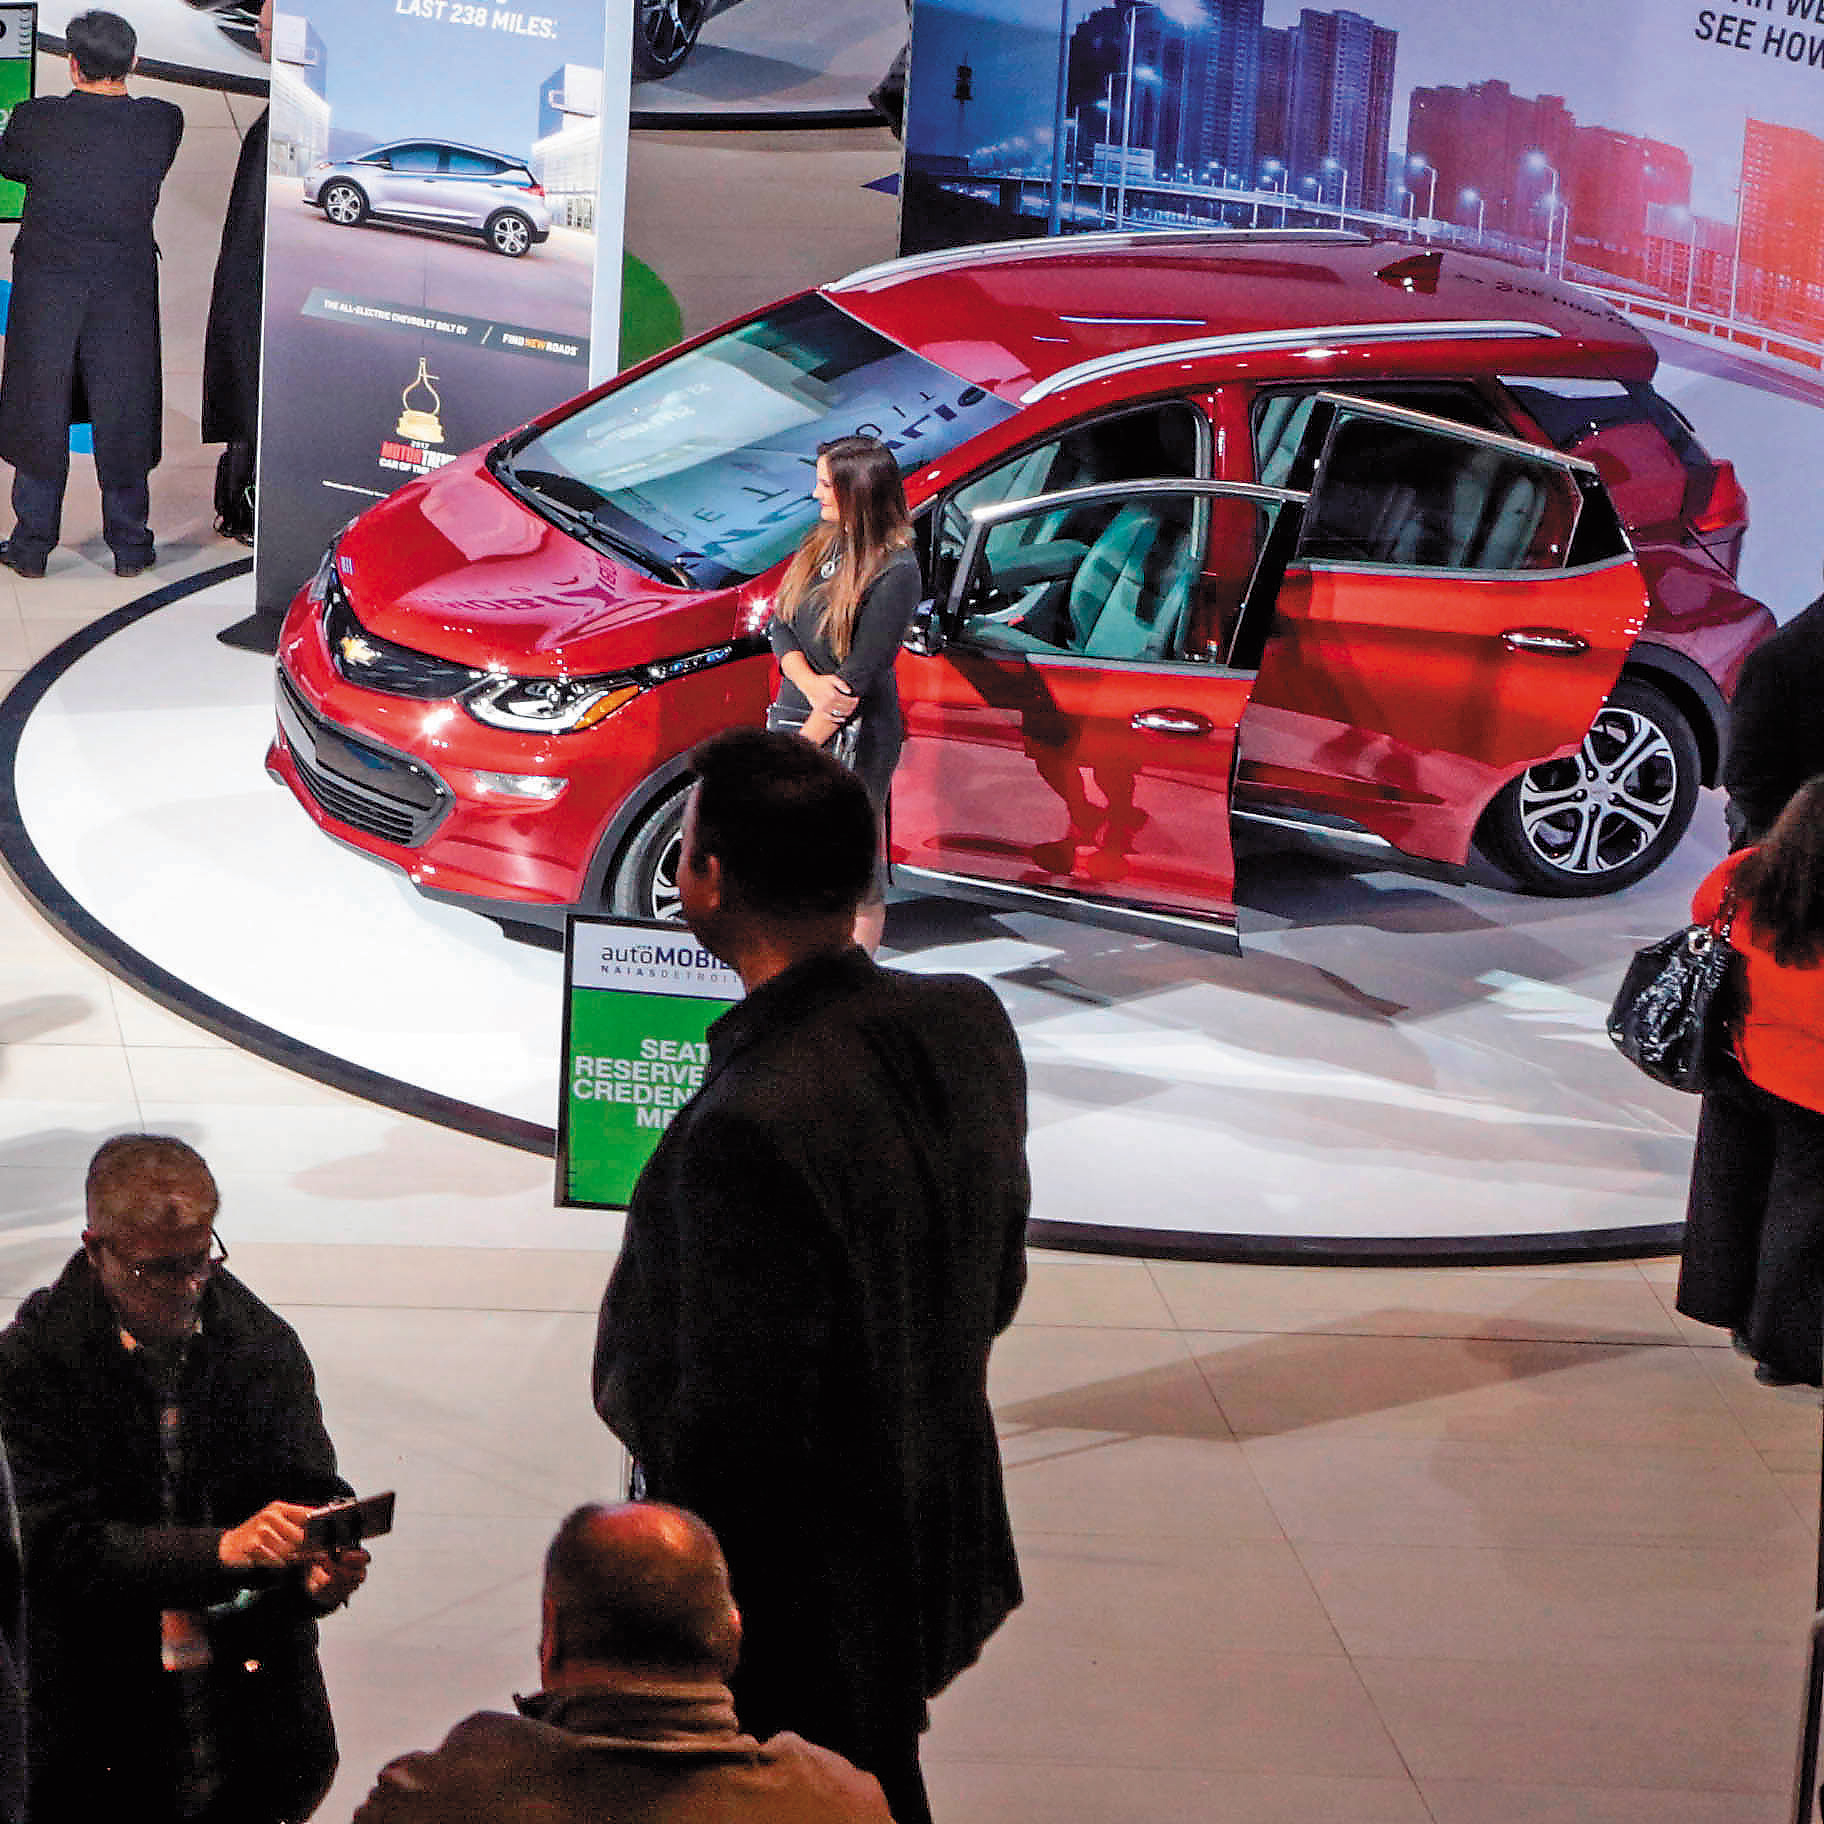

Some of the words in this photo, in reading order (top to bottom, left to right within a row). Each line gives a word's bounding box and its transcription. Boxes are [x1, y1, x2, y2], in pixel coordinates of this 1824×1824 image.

[449, 3, 487, 26] 238
[1695, 10, 1756, 50] SEE
[640, 1038, 710, 1064] SEAT
[575, 1055, 705, 1087] RESERVE
[573, 1078, 698, 1107] CREDEN
